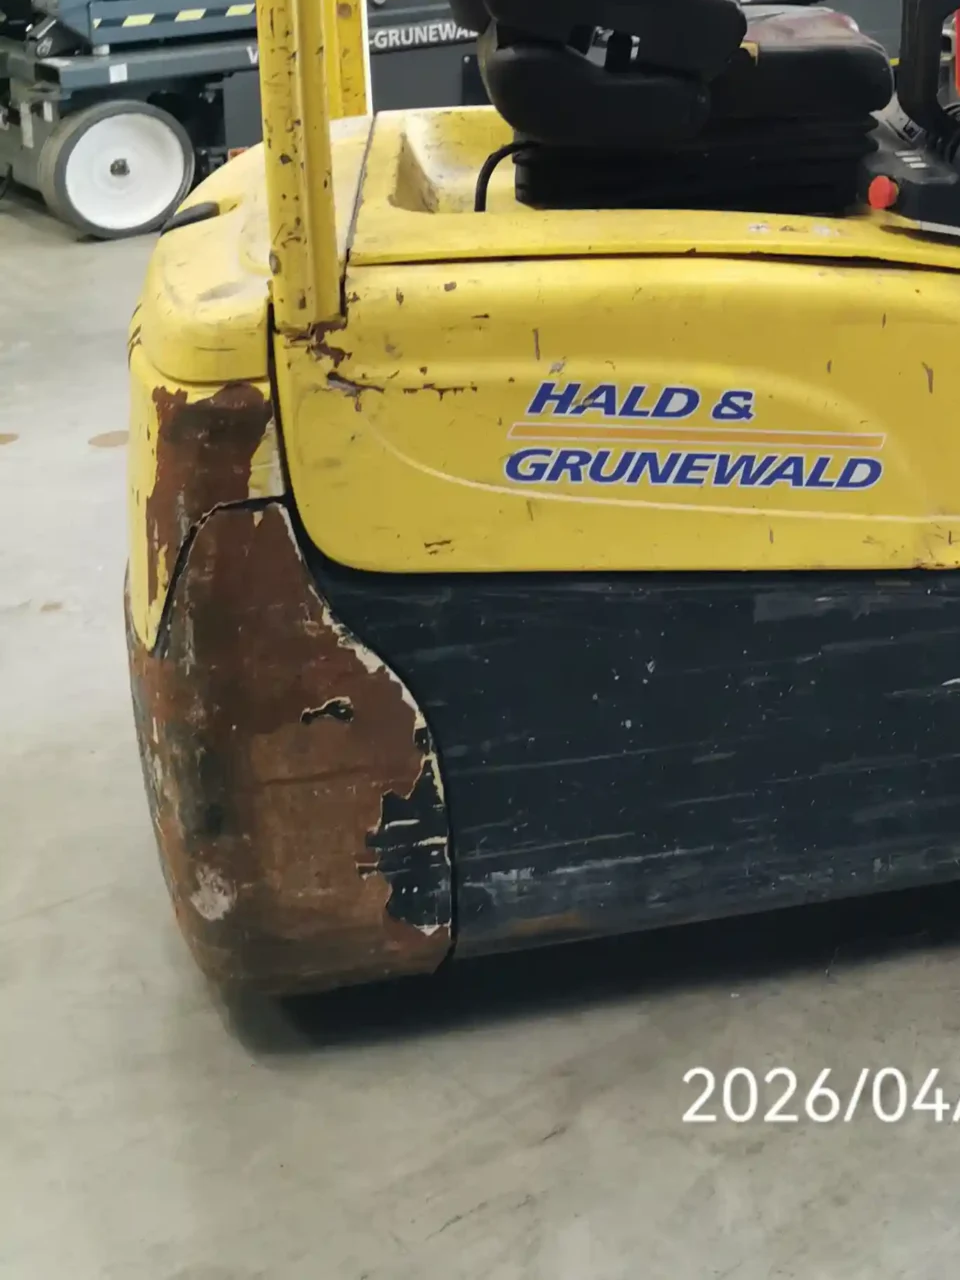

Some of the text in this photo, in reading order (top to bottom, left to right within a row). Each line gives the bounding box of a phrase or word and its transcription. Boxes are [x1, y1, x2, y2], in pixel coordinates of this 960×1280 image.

[527, 382, 756, 421] HALD &
[504, 448, 883, 490] GRUNEWALD
